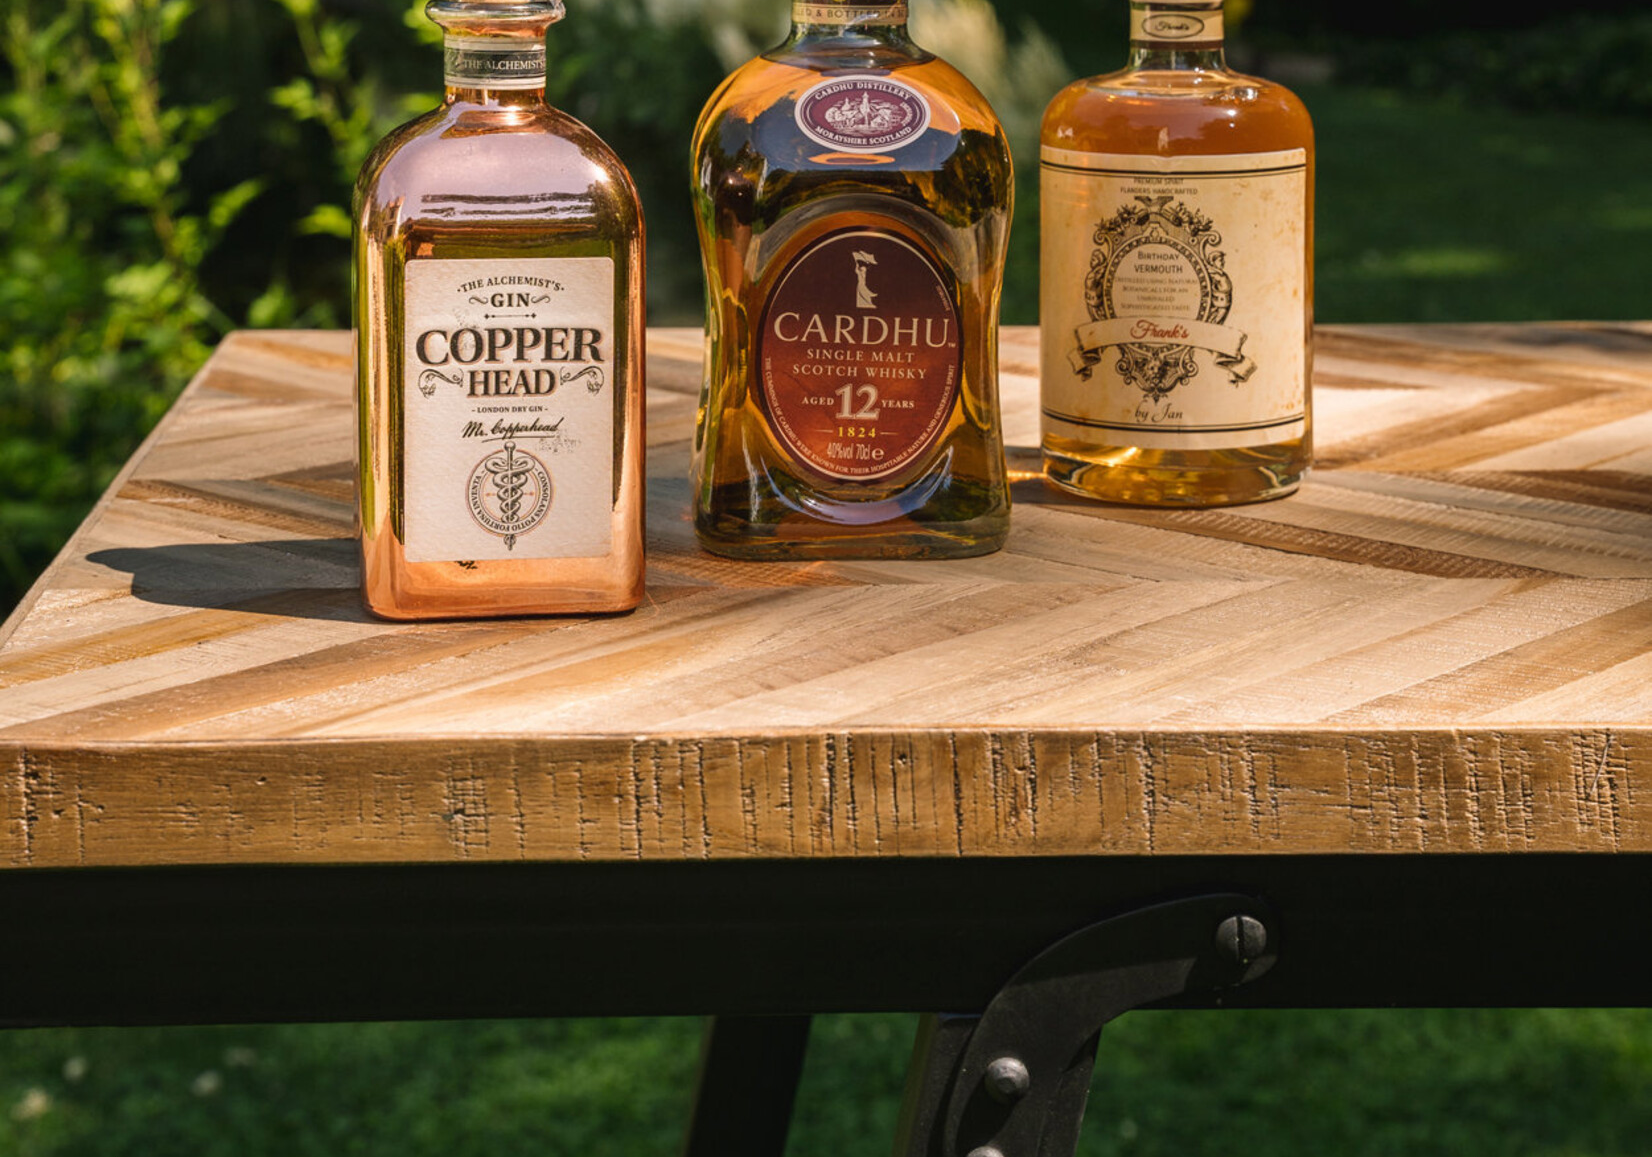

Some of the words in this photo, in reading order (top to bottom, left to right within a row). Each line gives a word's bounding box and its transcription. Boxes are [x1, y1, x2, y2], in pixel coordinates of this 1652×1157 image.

[463, 59, 482, 69] THE
[814, 83, 854, 100] CARDHU
[857, 82, 910, 101] DISTILLERY
[815, 126, 868, 144] MORAYSHIRE
[869, 126, 912, 144] SCOTLAND
[1133, 177, 1162, 185] PREMIUM
[1152, 187, 1198, 195] HANDCRAFTED
[1134, 264, 1183, 274] VERMOUTH
[460, 278, 484, 293] THE
[486, 276, 561, 291] ALCHEMIST'S
[490, 293, 531, 308] GIN
[774, 311, 949, 348] CARDHU
[1130, 319, 1189, 339] Frank's
[416, 327, 605, 366] COPPER
[806, 348, 864, 361] SINGLE
[871, 352, 915, 363] MALT
[793, 363, 858, 377] SCOTCH
[866, 367, 927, 379] WHISKY
[466, 369, 556, 398] HEAD
[801, 396, 835, 406] AGED
[835, 383, 880, 421] 12
[881, 399, 915, 409] YEARS
[774, 407, 783, 416] OF
[779, 416, 798, 442] CARDHU
[796, 439, 812, 457] WERE
[811, 453, 835, 470] KNOWN
[835, 465, 849, 474] FOR
[870, 452, 908, 473] HOSPITABLE
[907, 433, 928, 455] NATURE
[926, 420, 937, 435] AND
[934, 385, 951, 420] GENEROUS
[944, 364, 955, 386] SPIRIT
[1134, 400, 1150, 423] by
[1150, 403, 1183, 423] Jan
[462, 420, 488, 438] Mr.
[490, 417, 564, 439] Copperhead
[837, 426, 876, 439] 1824
[855, 443, 871, 460] 70cl
[471, 475, 482, 510] INVENTA
[534, 470, 549, 518] CONSOLANS
[477, 509, 510, 531] FORTUNA
[511, 516, 536, 531] POTIO
